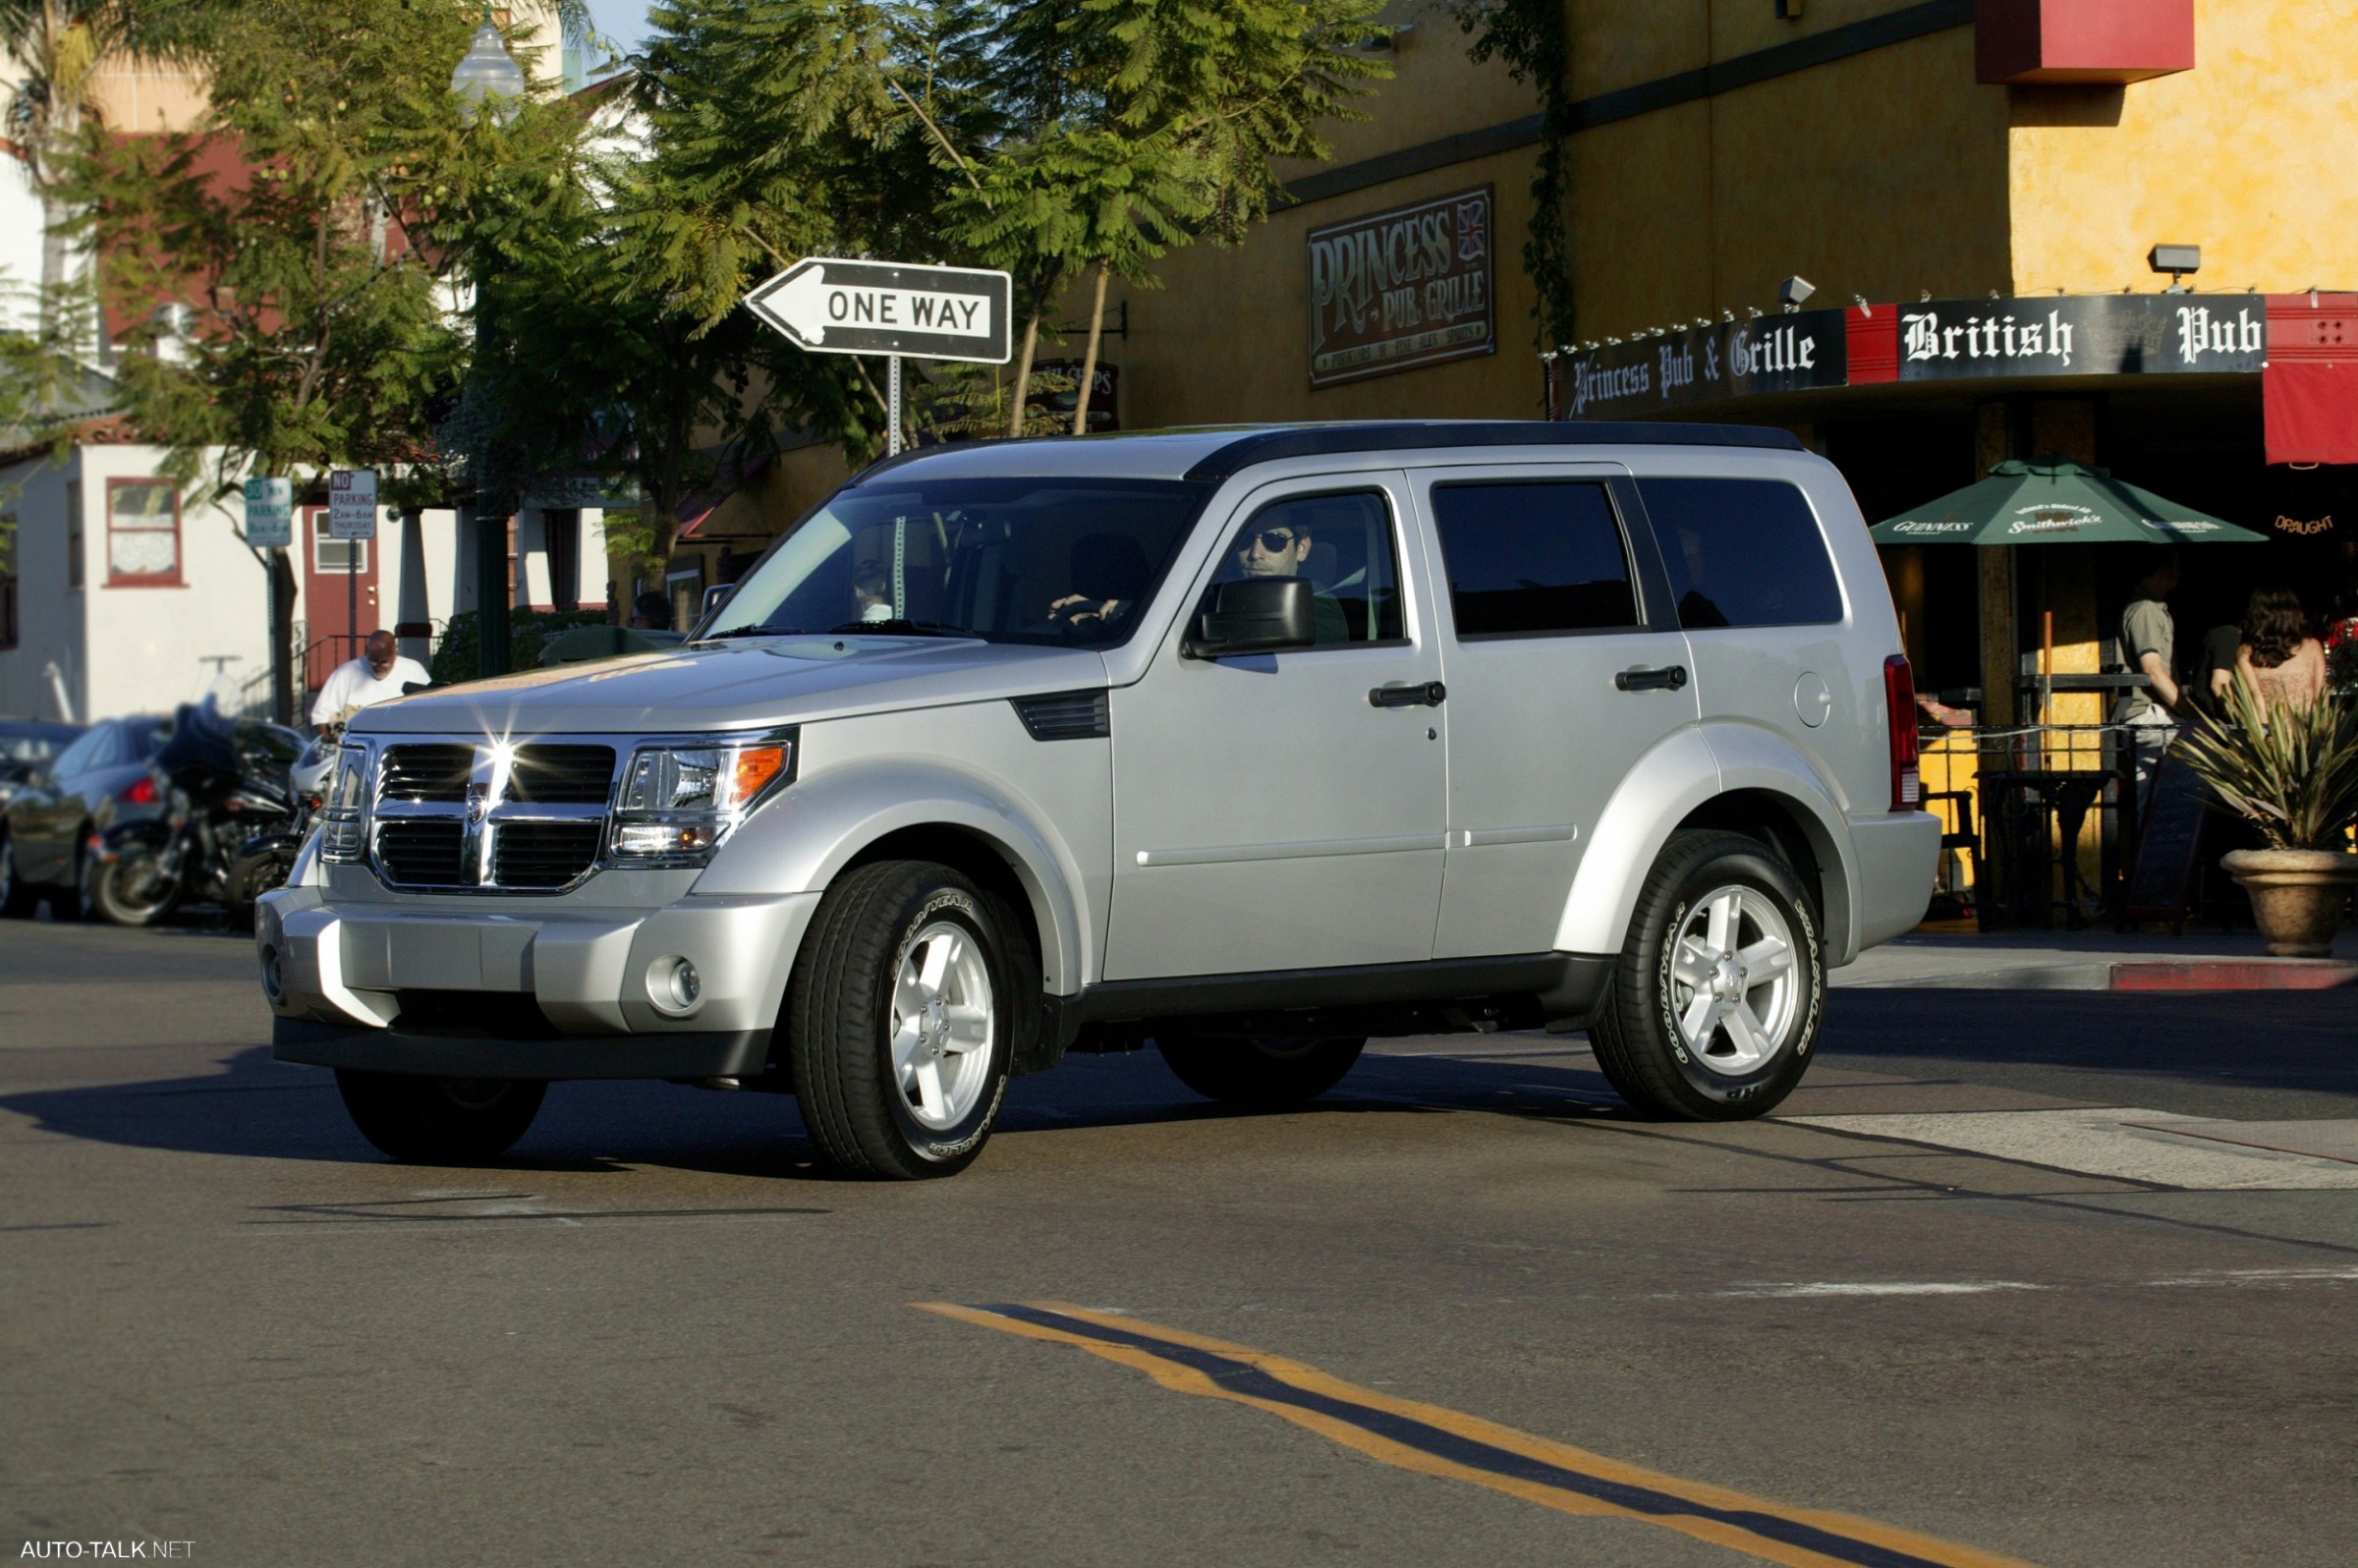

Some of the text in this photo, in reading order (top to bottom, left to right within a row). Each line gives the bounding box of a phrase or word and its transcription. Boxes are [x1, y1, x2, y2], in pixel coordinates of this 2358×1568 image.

[1311, 207, 1451, 356] PRINCESS
[1424, 270, 1486, 322] GRILLE
[828, 291, 981, 330] ONE WAY
[1901, 306, 2262, 366] British Pub
[1067, 364, 1112, 395] CHPS
[1575, 325, 1816, 415] Princess Pub & Grille
[333, 473, 350, 488] NO
[334, 493, 373, 506] PARKING
[248, 504, 290, 517] PARKING
[1892, 521, 1974, 532] GUINNESS
[2008, 515, 2103, 533] Smithwick's
[2274, 515, 2333, 535] DRAUGHT
[892, 892, 974, 981] GOODYEAR
[1657, 900, 1689, 1064] GOODYEAR
[1794, 898, 1822, 1056] WRANGLER
